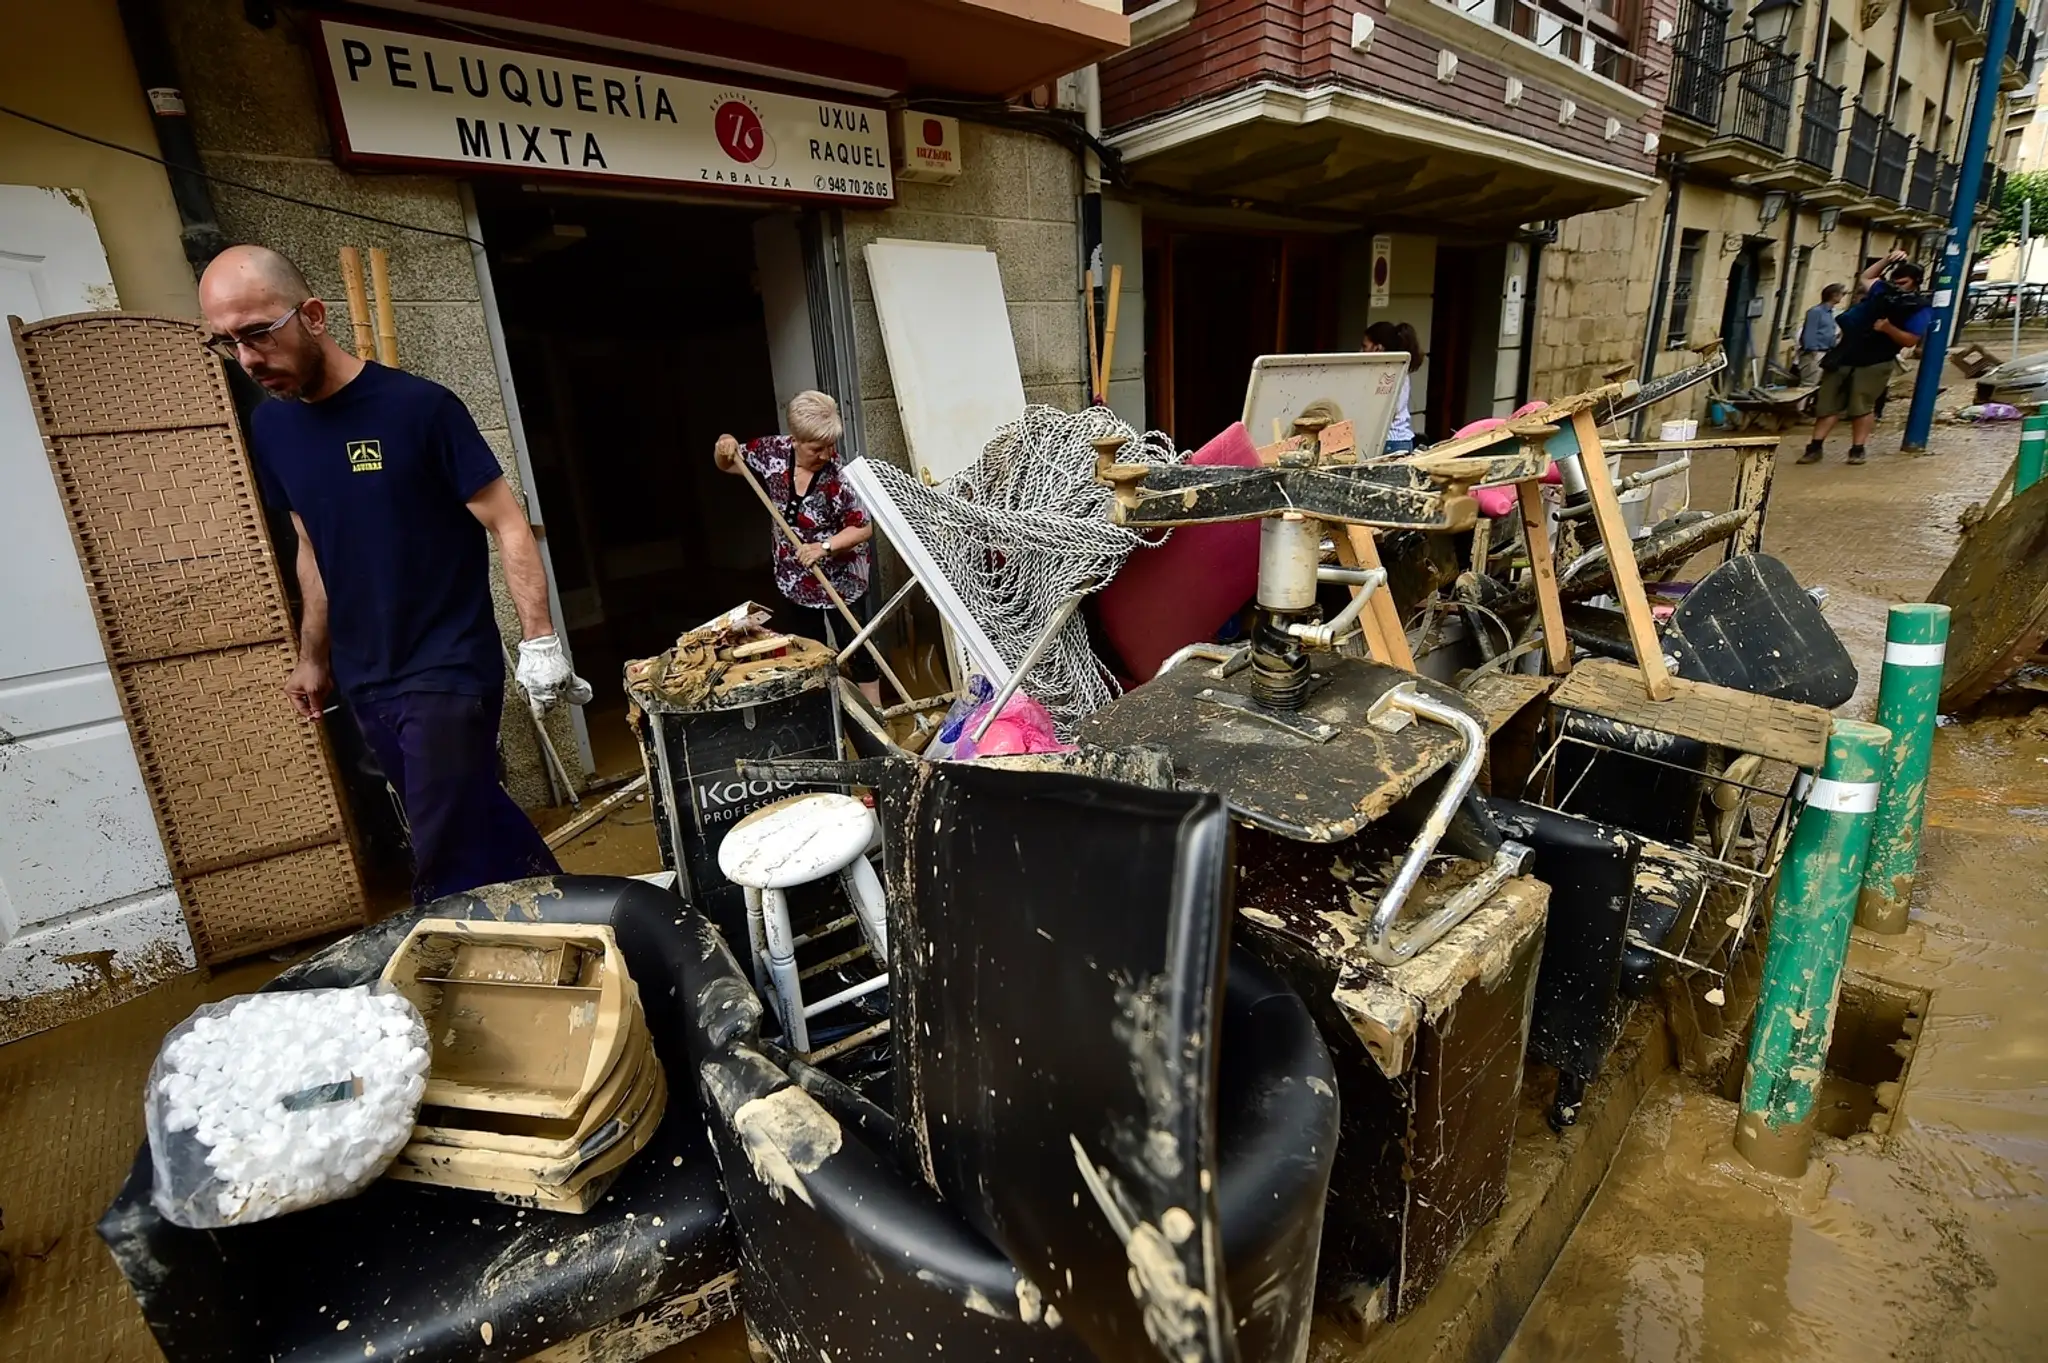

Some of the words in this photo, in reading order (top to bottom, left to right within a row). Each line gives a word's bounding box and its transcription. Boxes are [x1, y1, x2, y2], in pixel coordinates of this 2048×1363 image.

[342, 38, 679, 124] PELUQUERÍA
[818, 106, 870, 134] UXUA
[456, 117, 608, 169] MIXTA
[809, 138, 886, 168] RAQUEL
[700, 168, 792, 188] ZABALZA
[828, 176, 847, 193] 948
[849, 178, 860, 194] 70
[862, 180, 875, 196] 26
[876, 182, 888, 197] 05
